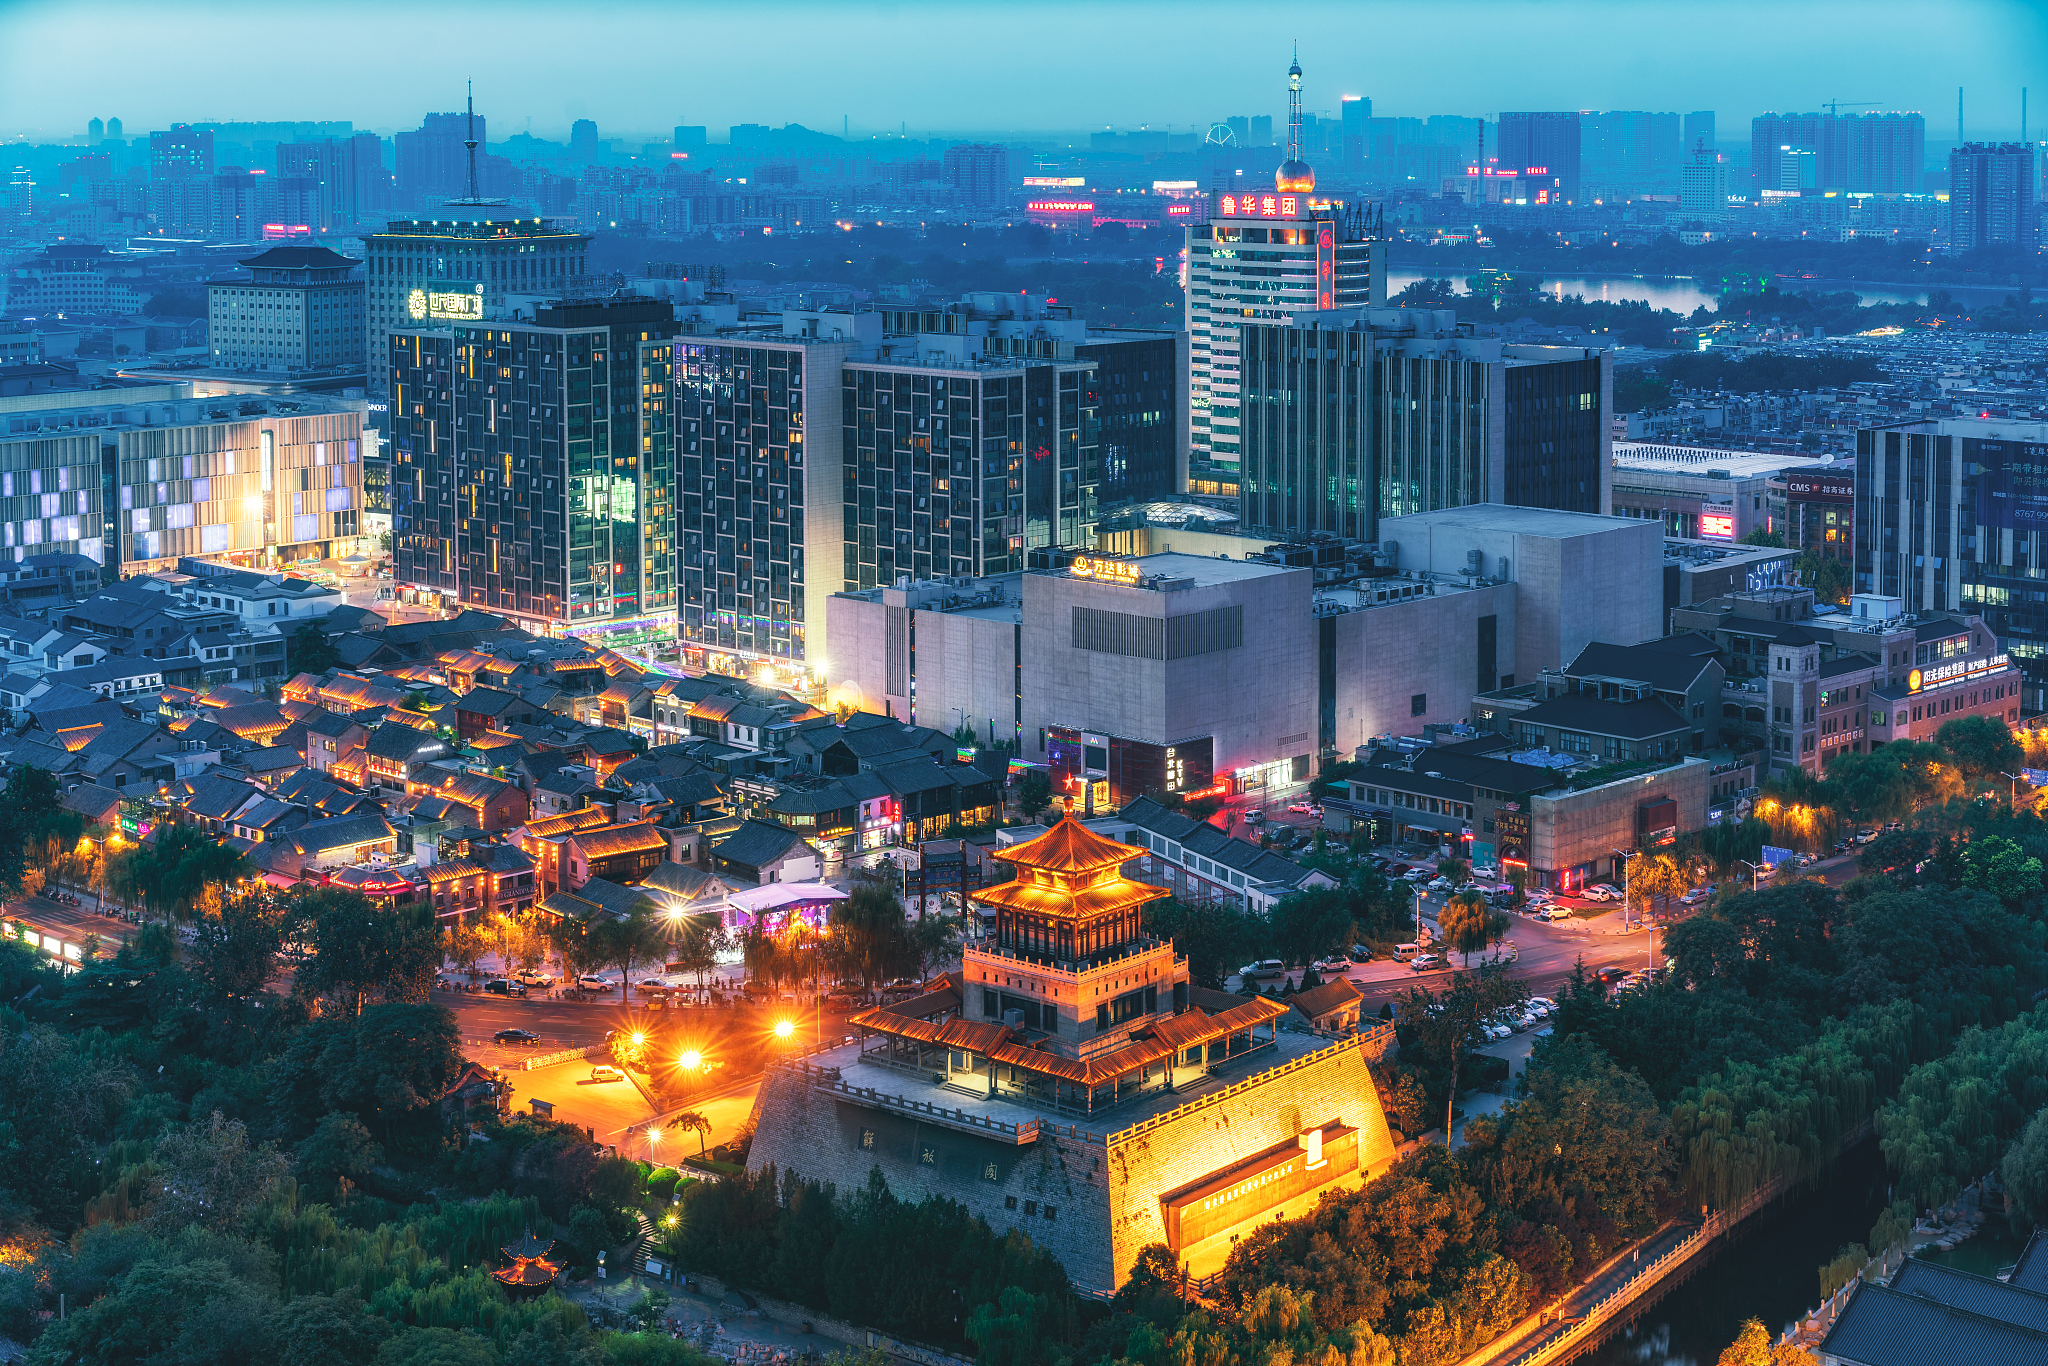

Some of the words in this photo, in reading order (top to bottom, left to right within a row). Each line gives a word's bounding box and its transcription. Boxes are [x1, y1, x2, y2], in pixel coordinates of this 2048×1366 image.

[1222, 195, 1297, 216] 鲁华集团
[428, 292, 483, 312] 世茂国际广场
[1790, 483, 1810, 492] CMS
[1822, 485, 1854, 495] 招商证券
[2014, 509, 2035, 518] 8767
[2036, 511, 2048, 520] 99
[1093, 559, 1139, 578] 万达影城
[1923, 661, 1965, 683] 阳光保险集团
